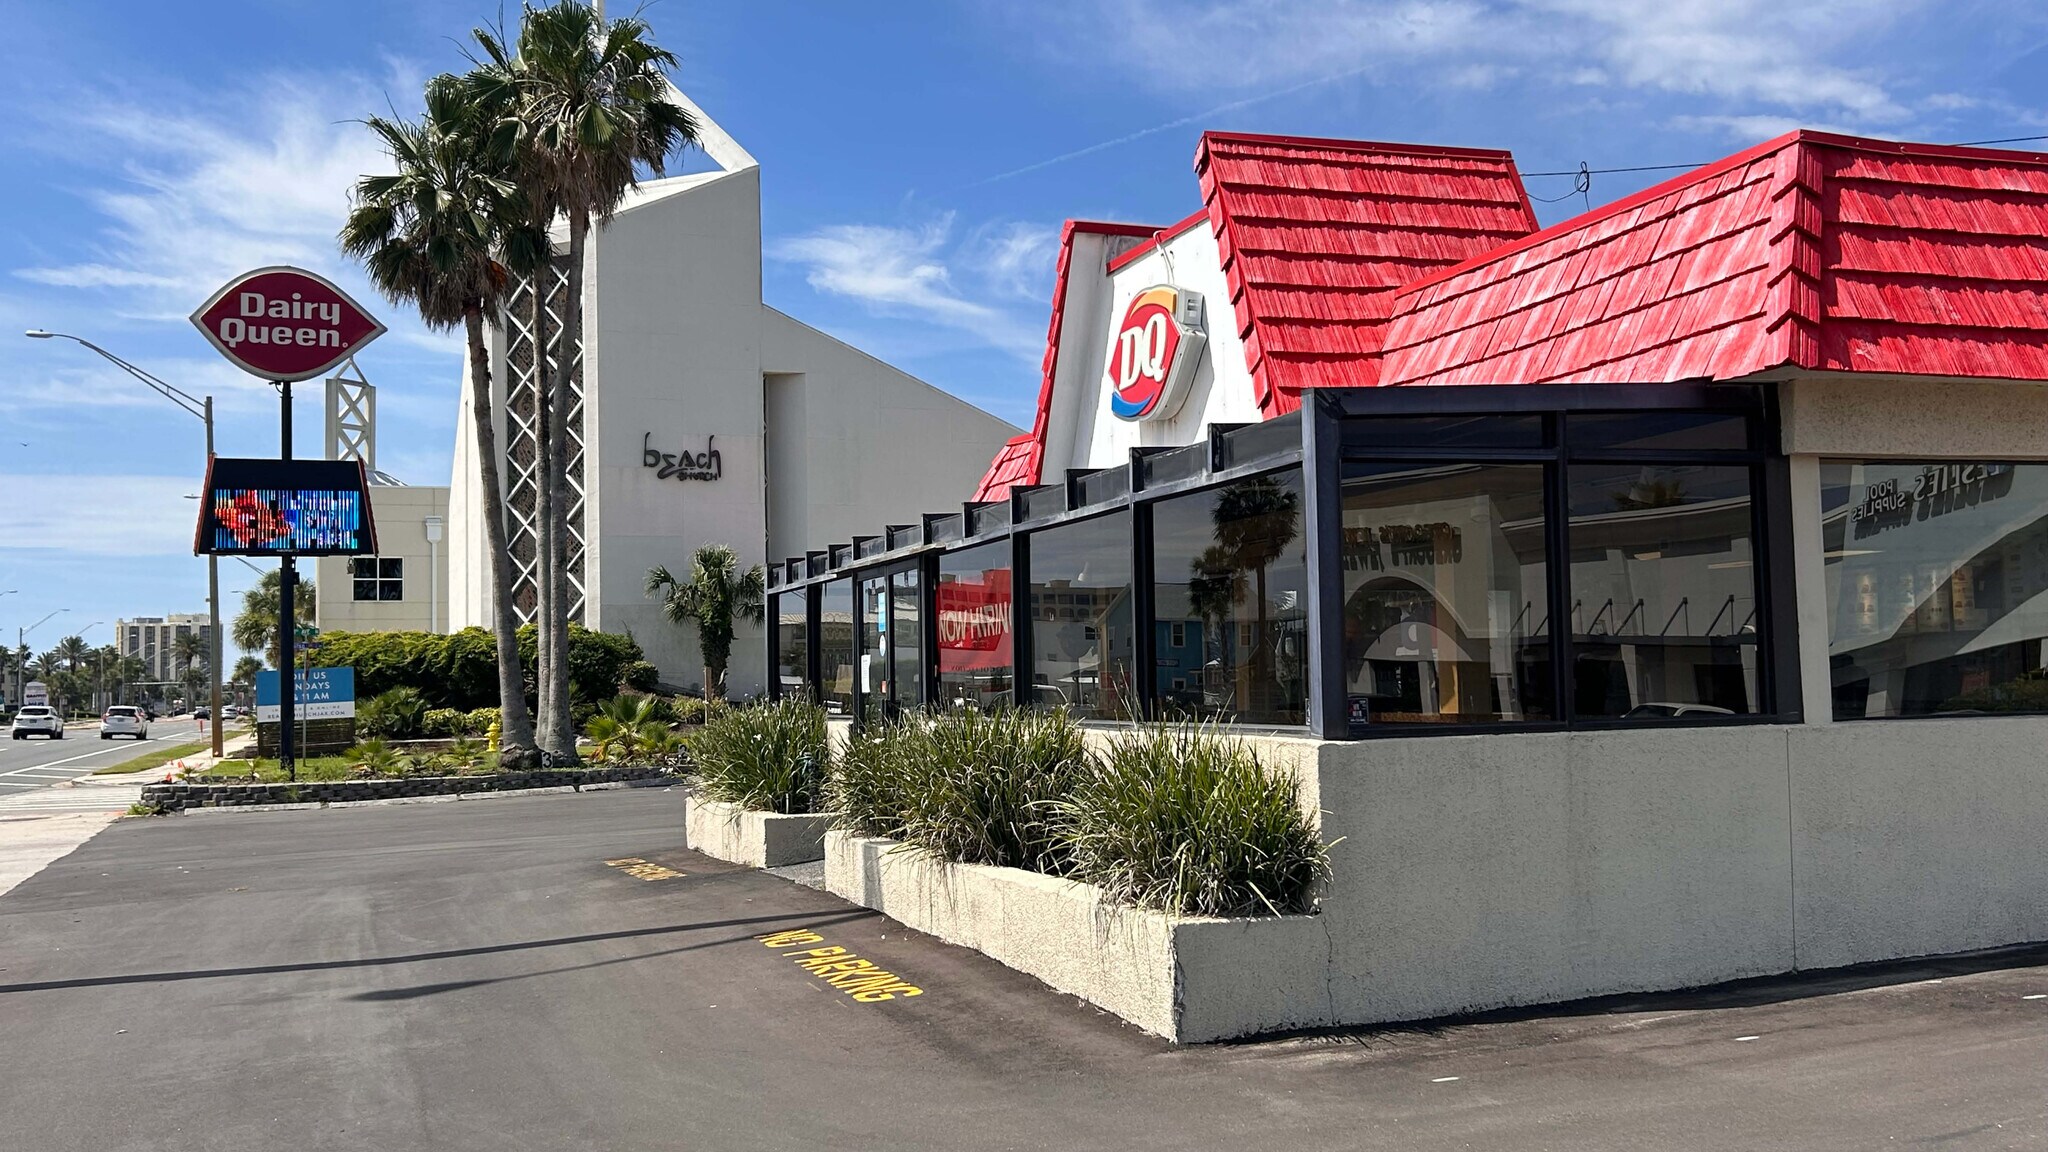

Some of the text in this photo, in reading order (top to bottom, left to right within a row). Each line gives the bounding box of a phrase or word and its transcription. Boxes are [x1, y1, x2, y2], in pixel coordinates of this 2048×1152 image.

[240, 292, 341, 326] Dairy
[219, 318, 340, 348] Queen
[1119, 312, 1168, 391] DQ
[938, 609, 968, 643] NOW
[294, 681, 331, 691] NDAYS
[313, 671, 327, 680] US
[313, 692, 330, 700] AM
[753, 928, 924, 1003] NO PARKING
